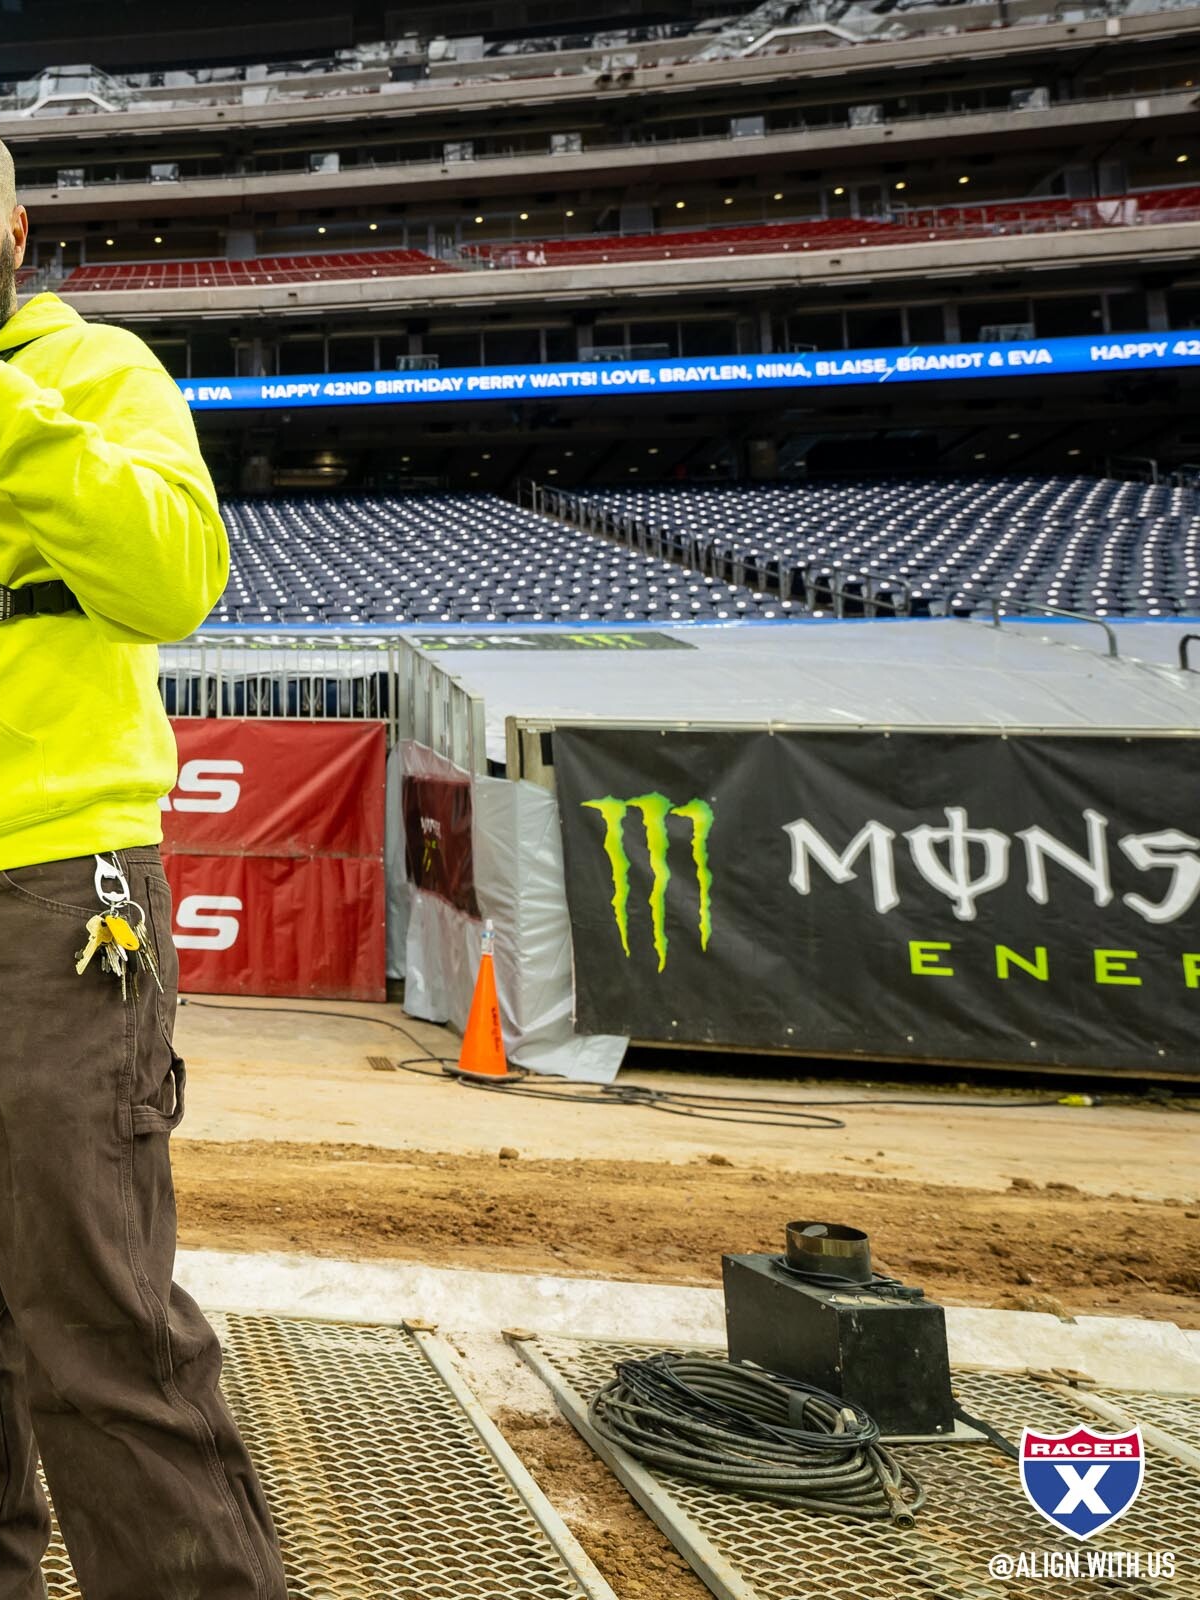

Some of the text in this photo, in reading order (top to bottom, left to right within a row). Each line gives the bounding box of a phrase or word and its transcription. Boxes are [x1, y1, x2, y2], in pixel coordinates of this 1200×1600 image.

[1090, 342, 1169, 360] HAPPY
[261, 384, 321, 399] HAPPY
[323, 381, 372, 396] 42ND
[374, 378, 465, 394] BIRTHDAY
[467, 375, 528, 390] PERRY
[601, 369, 656, 385] LOVE,
[659, 365, 752, 382] BRAYLEN,
[756, 363, 812, 378] NINA,
[897, 353, 984, 371] BRANDT
[987, 352, 1004, 366] &
[1008, 349, 1052, 365] EVA
[198, 387, 233, 400] EVA
